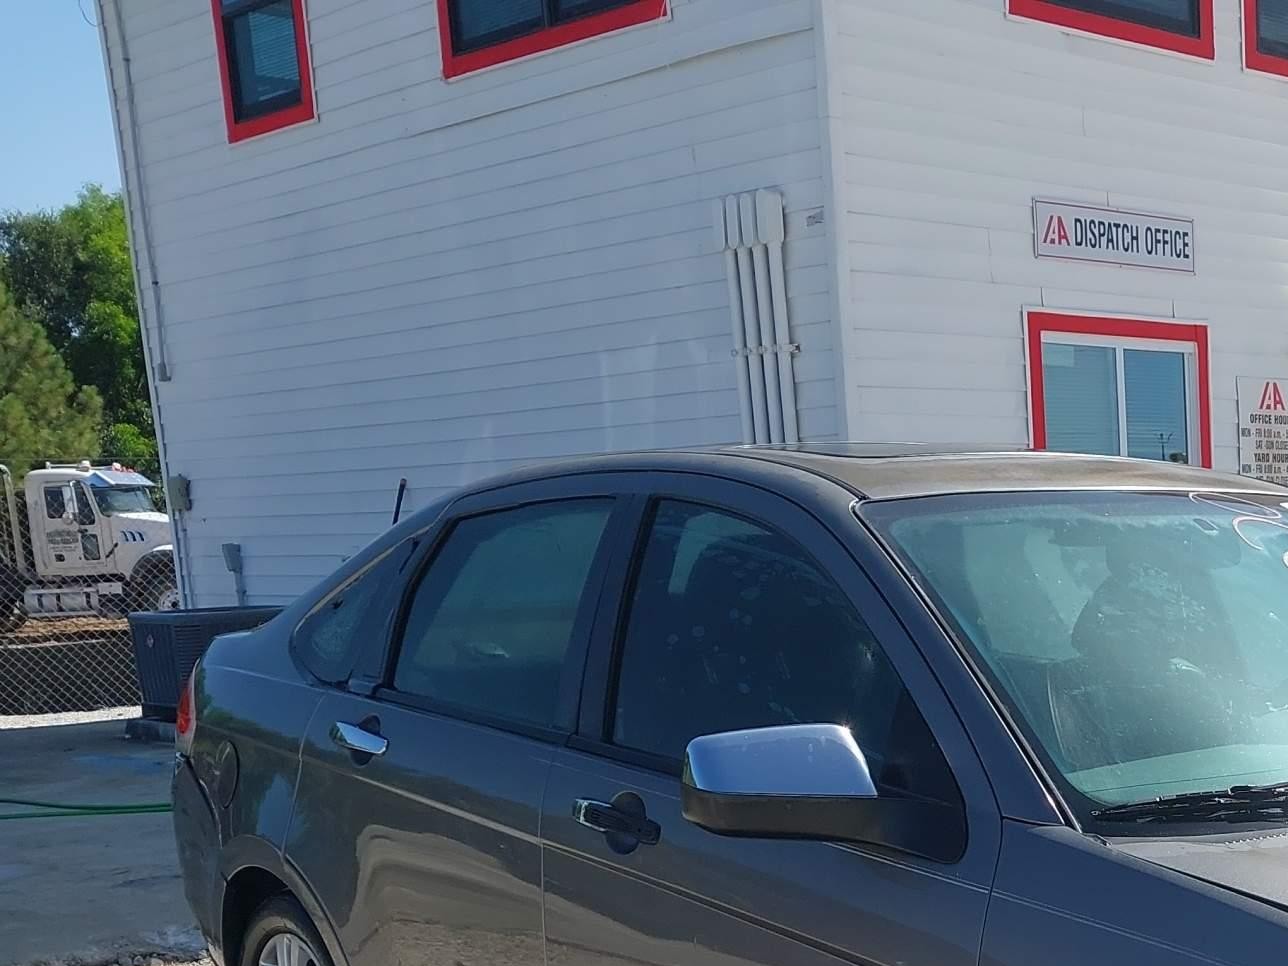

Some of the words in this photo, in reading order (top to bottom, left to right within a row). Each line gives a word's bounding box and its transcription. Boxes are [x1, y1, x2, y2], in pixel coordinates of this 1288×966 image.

[1074, 217, 1140, 253] DISPATCH
[1145, 226, 1190, 259] OFFICE
[1249, 413, 1272, 425] OFFICE
[1254, 453, 1269, 463] YARD
